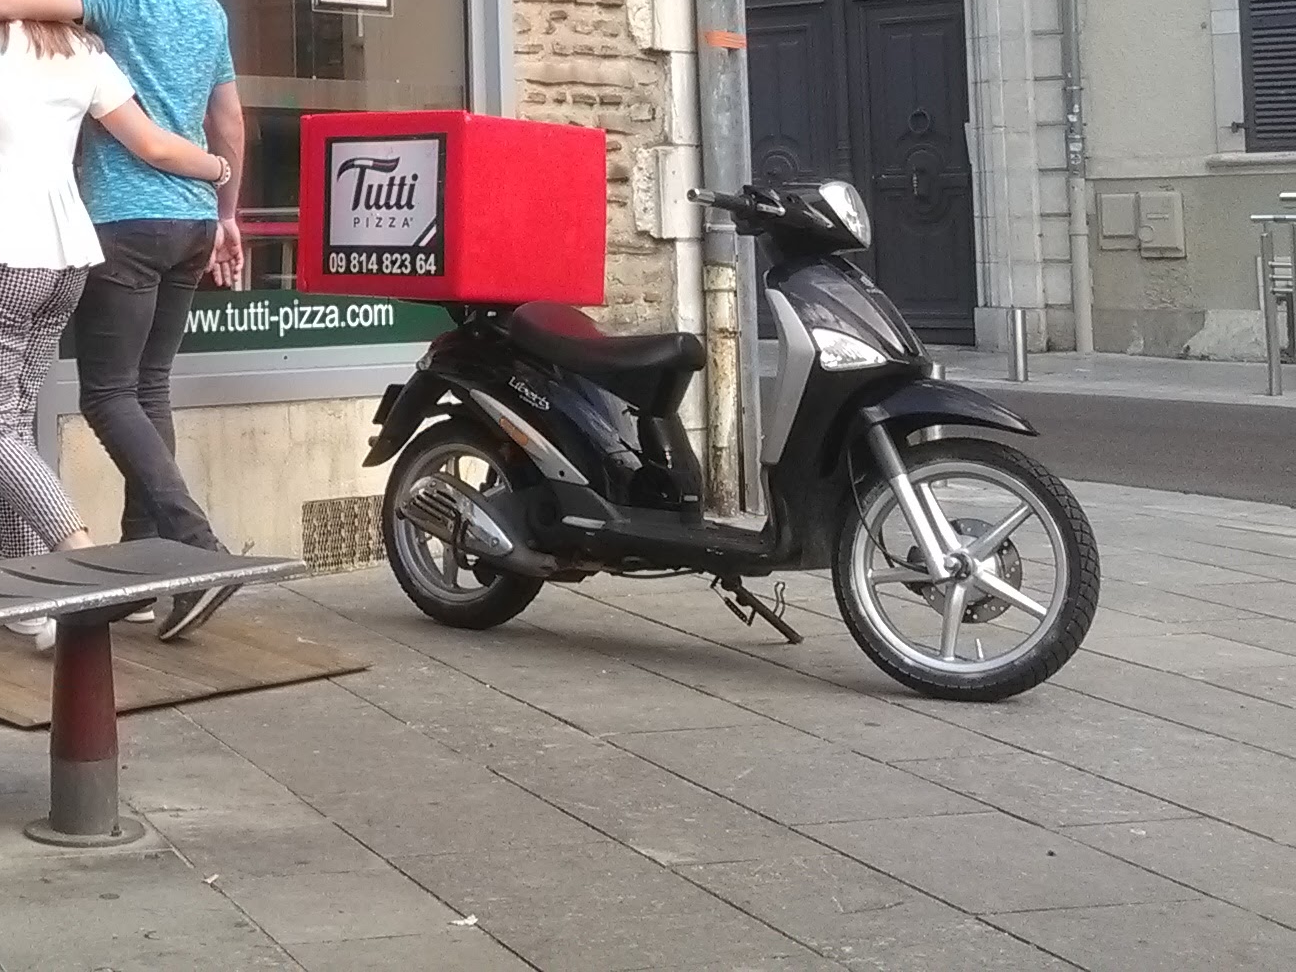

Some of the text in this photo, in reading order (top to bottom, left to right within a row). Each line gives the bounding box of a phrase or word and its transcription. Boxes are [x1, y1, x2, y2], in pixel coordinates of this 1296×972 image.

[337, 156, 419, 212] Tutti
[354, 216, 410, 228] PIZZA
[329, 253, 437, 275] 09 814 823 64
[184, 299, 394, 338] ww.tutti-pizza.com
